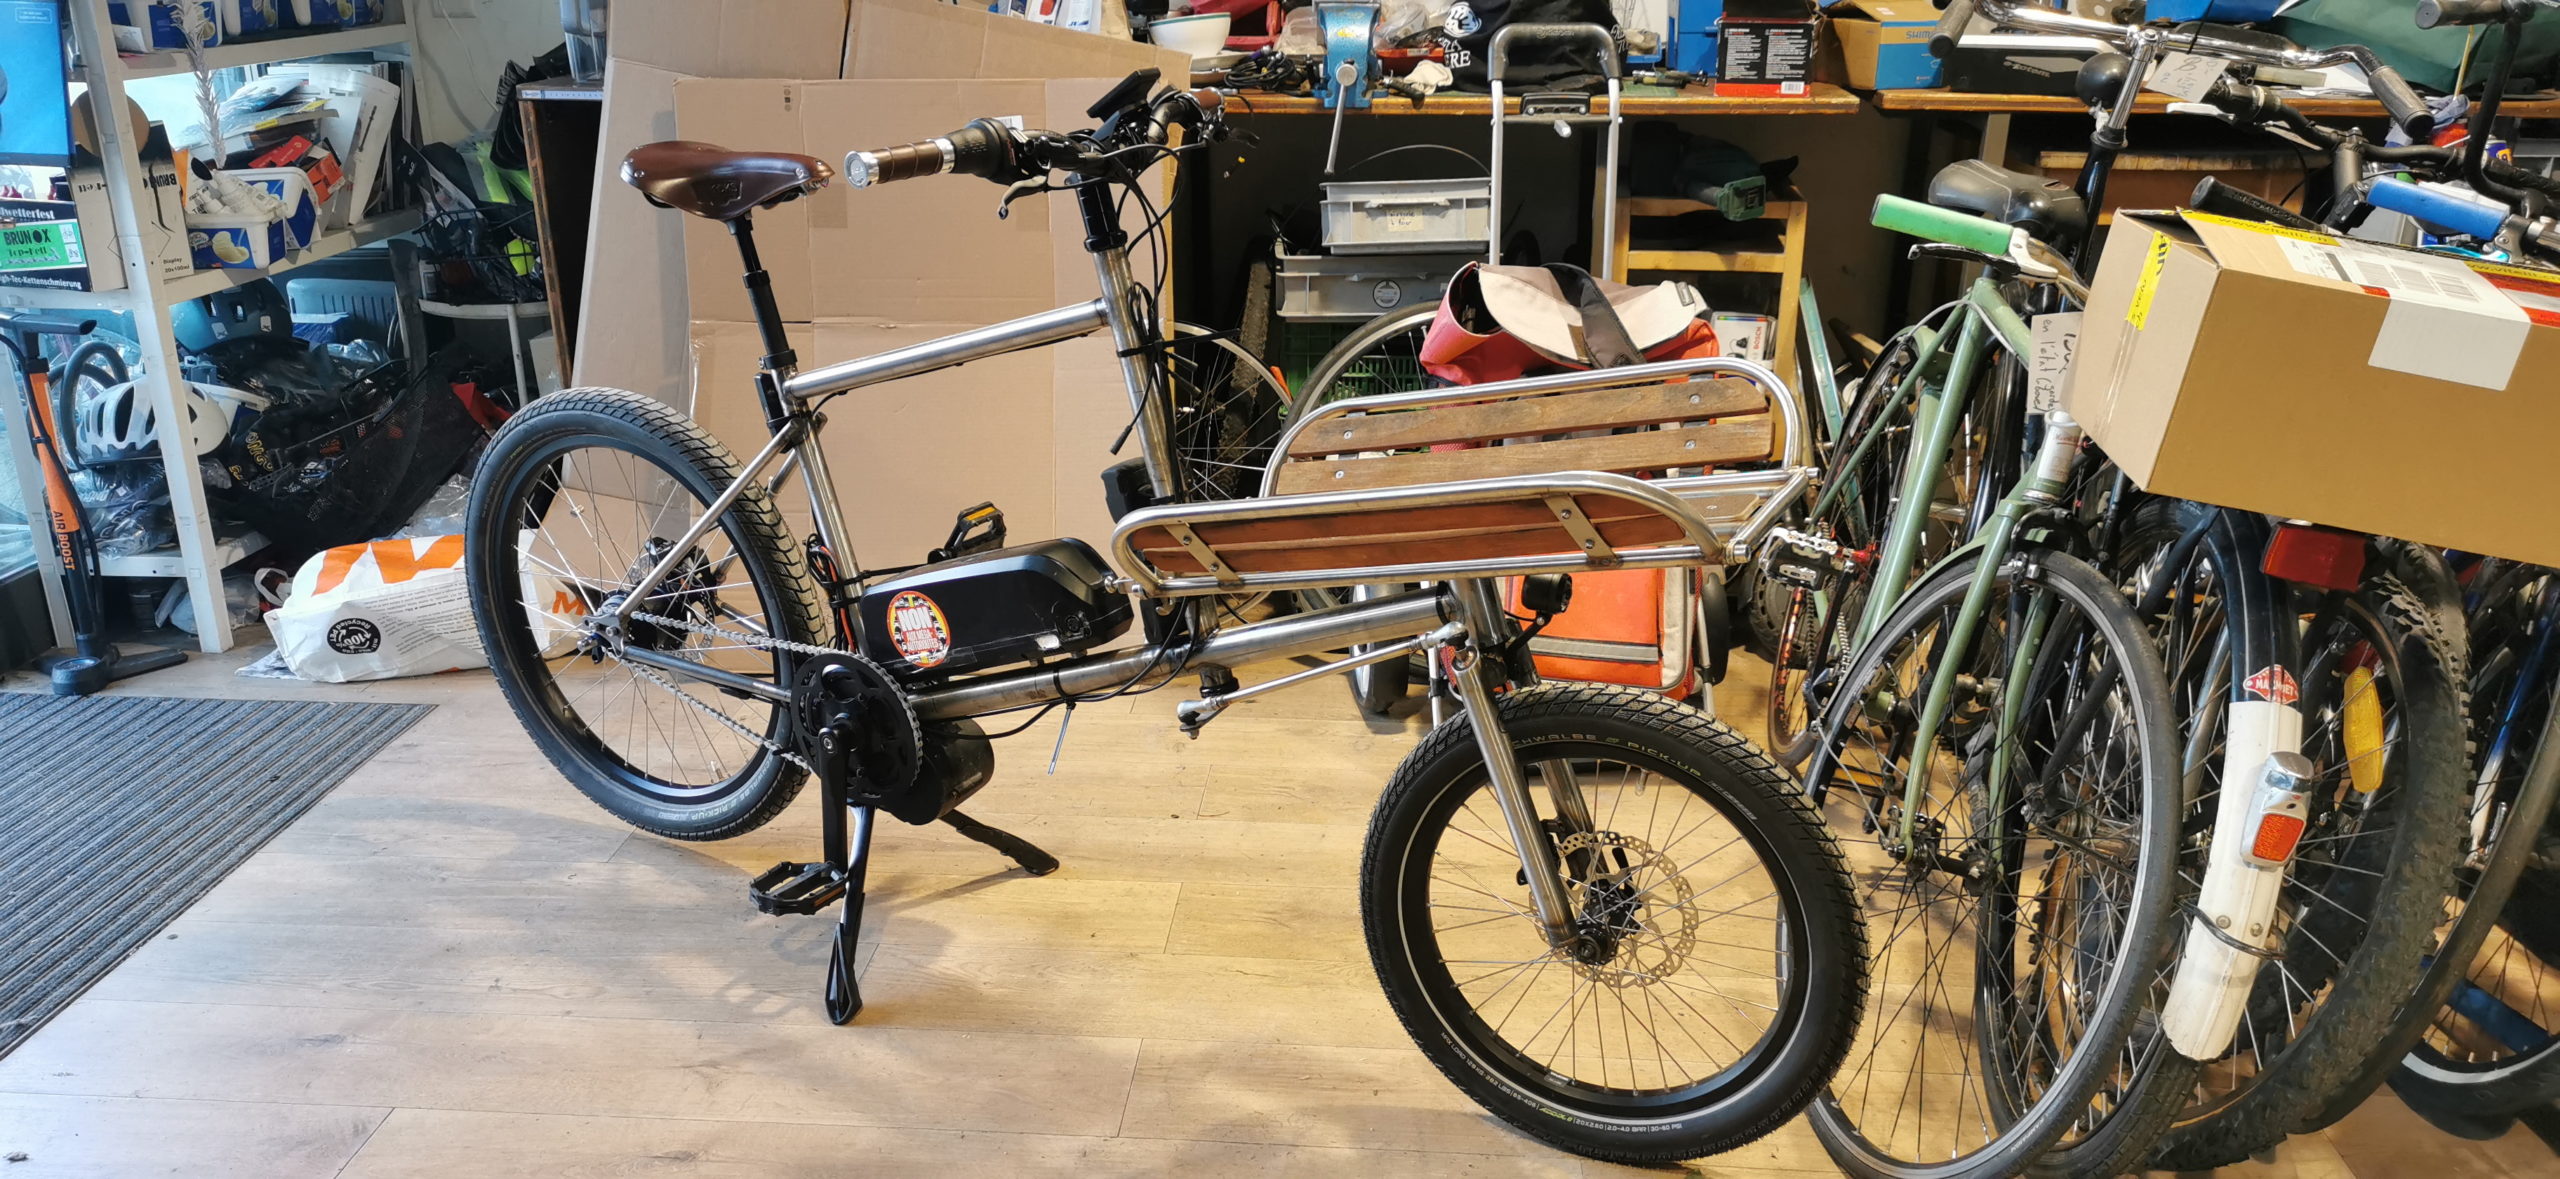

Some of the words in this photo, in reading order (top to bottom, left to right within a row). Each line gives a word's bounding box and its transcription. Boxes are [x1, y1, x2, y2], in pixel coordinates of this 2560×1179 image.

[1906, 30, 1932, 40] SHIM
[163, 257, 182, 265] Display
[53, 510, 66, 530] AIR
[58, 533, 76, 571] BOOST
[896, 606, 933, 633] NON
[329, 629, 339, 642] PET
[336, 632, 367, 648] 100%
[1512, 733, 1597, 747] CHWALBE
[1628, 741, 1702, 777] PICK-UP
[691, 803, 728, 821] PICK-UP
[1450, 1043, 1467, 1060] LOAD
